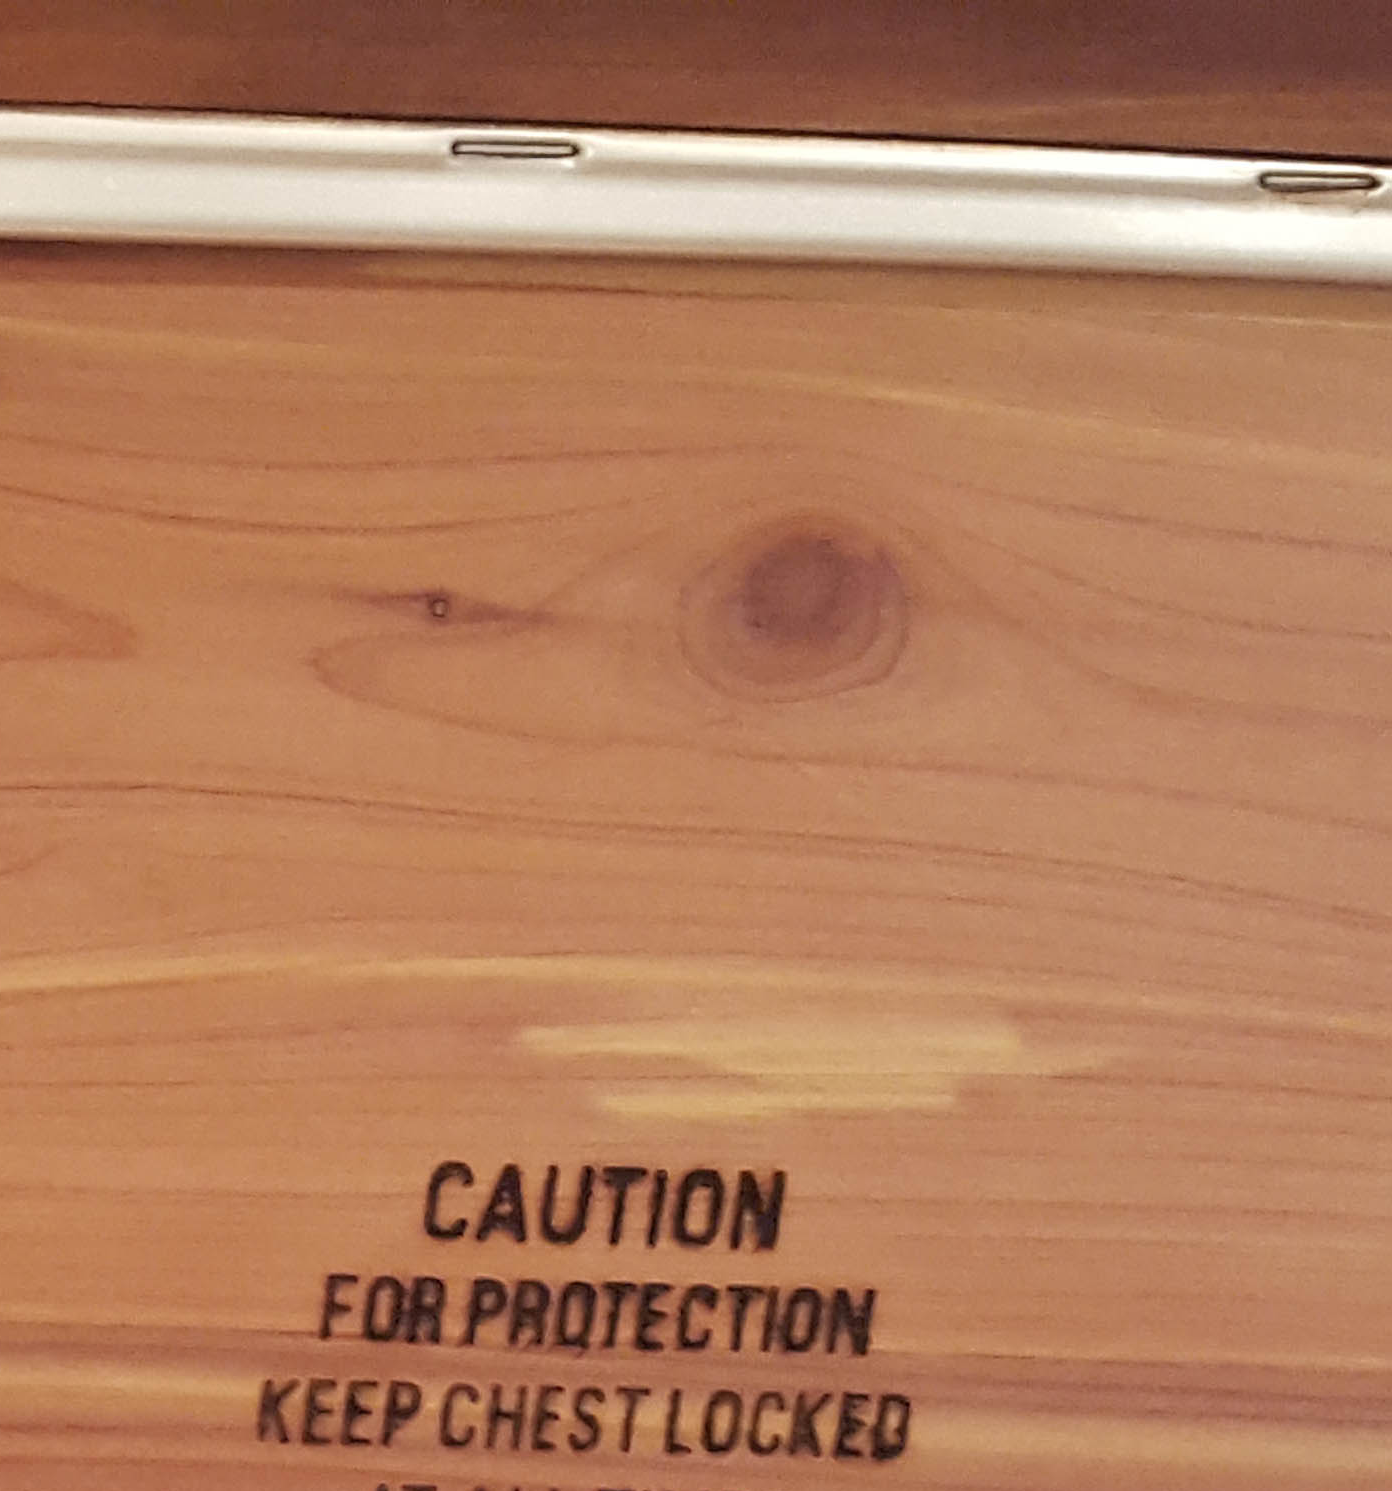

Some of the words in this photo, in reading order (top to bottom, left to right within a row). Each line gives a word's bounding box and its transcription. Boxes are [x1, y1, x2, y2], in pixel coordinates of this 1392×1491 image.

[423, 1160, 787, 1250] CAUTION
[320, 1274, 445, 1344] FOR
[460, 1277, 877, 1356] PROTECTION
[256, 1378, 423, 1446] KEEP
[439, 1383, 650, 1452] CHEST
[664, 1388, 910, 1460] LOCKED
